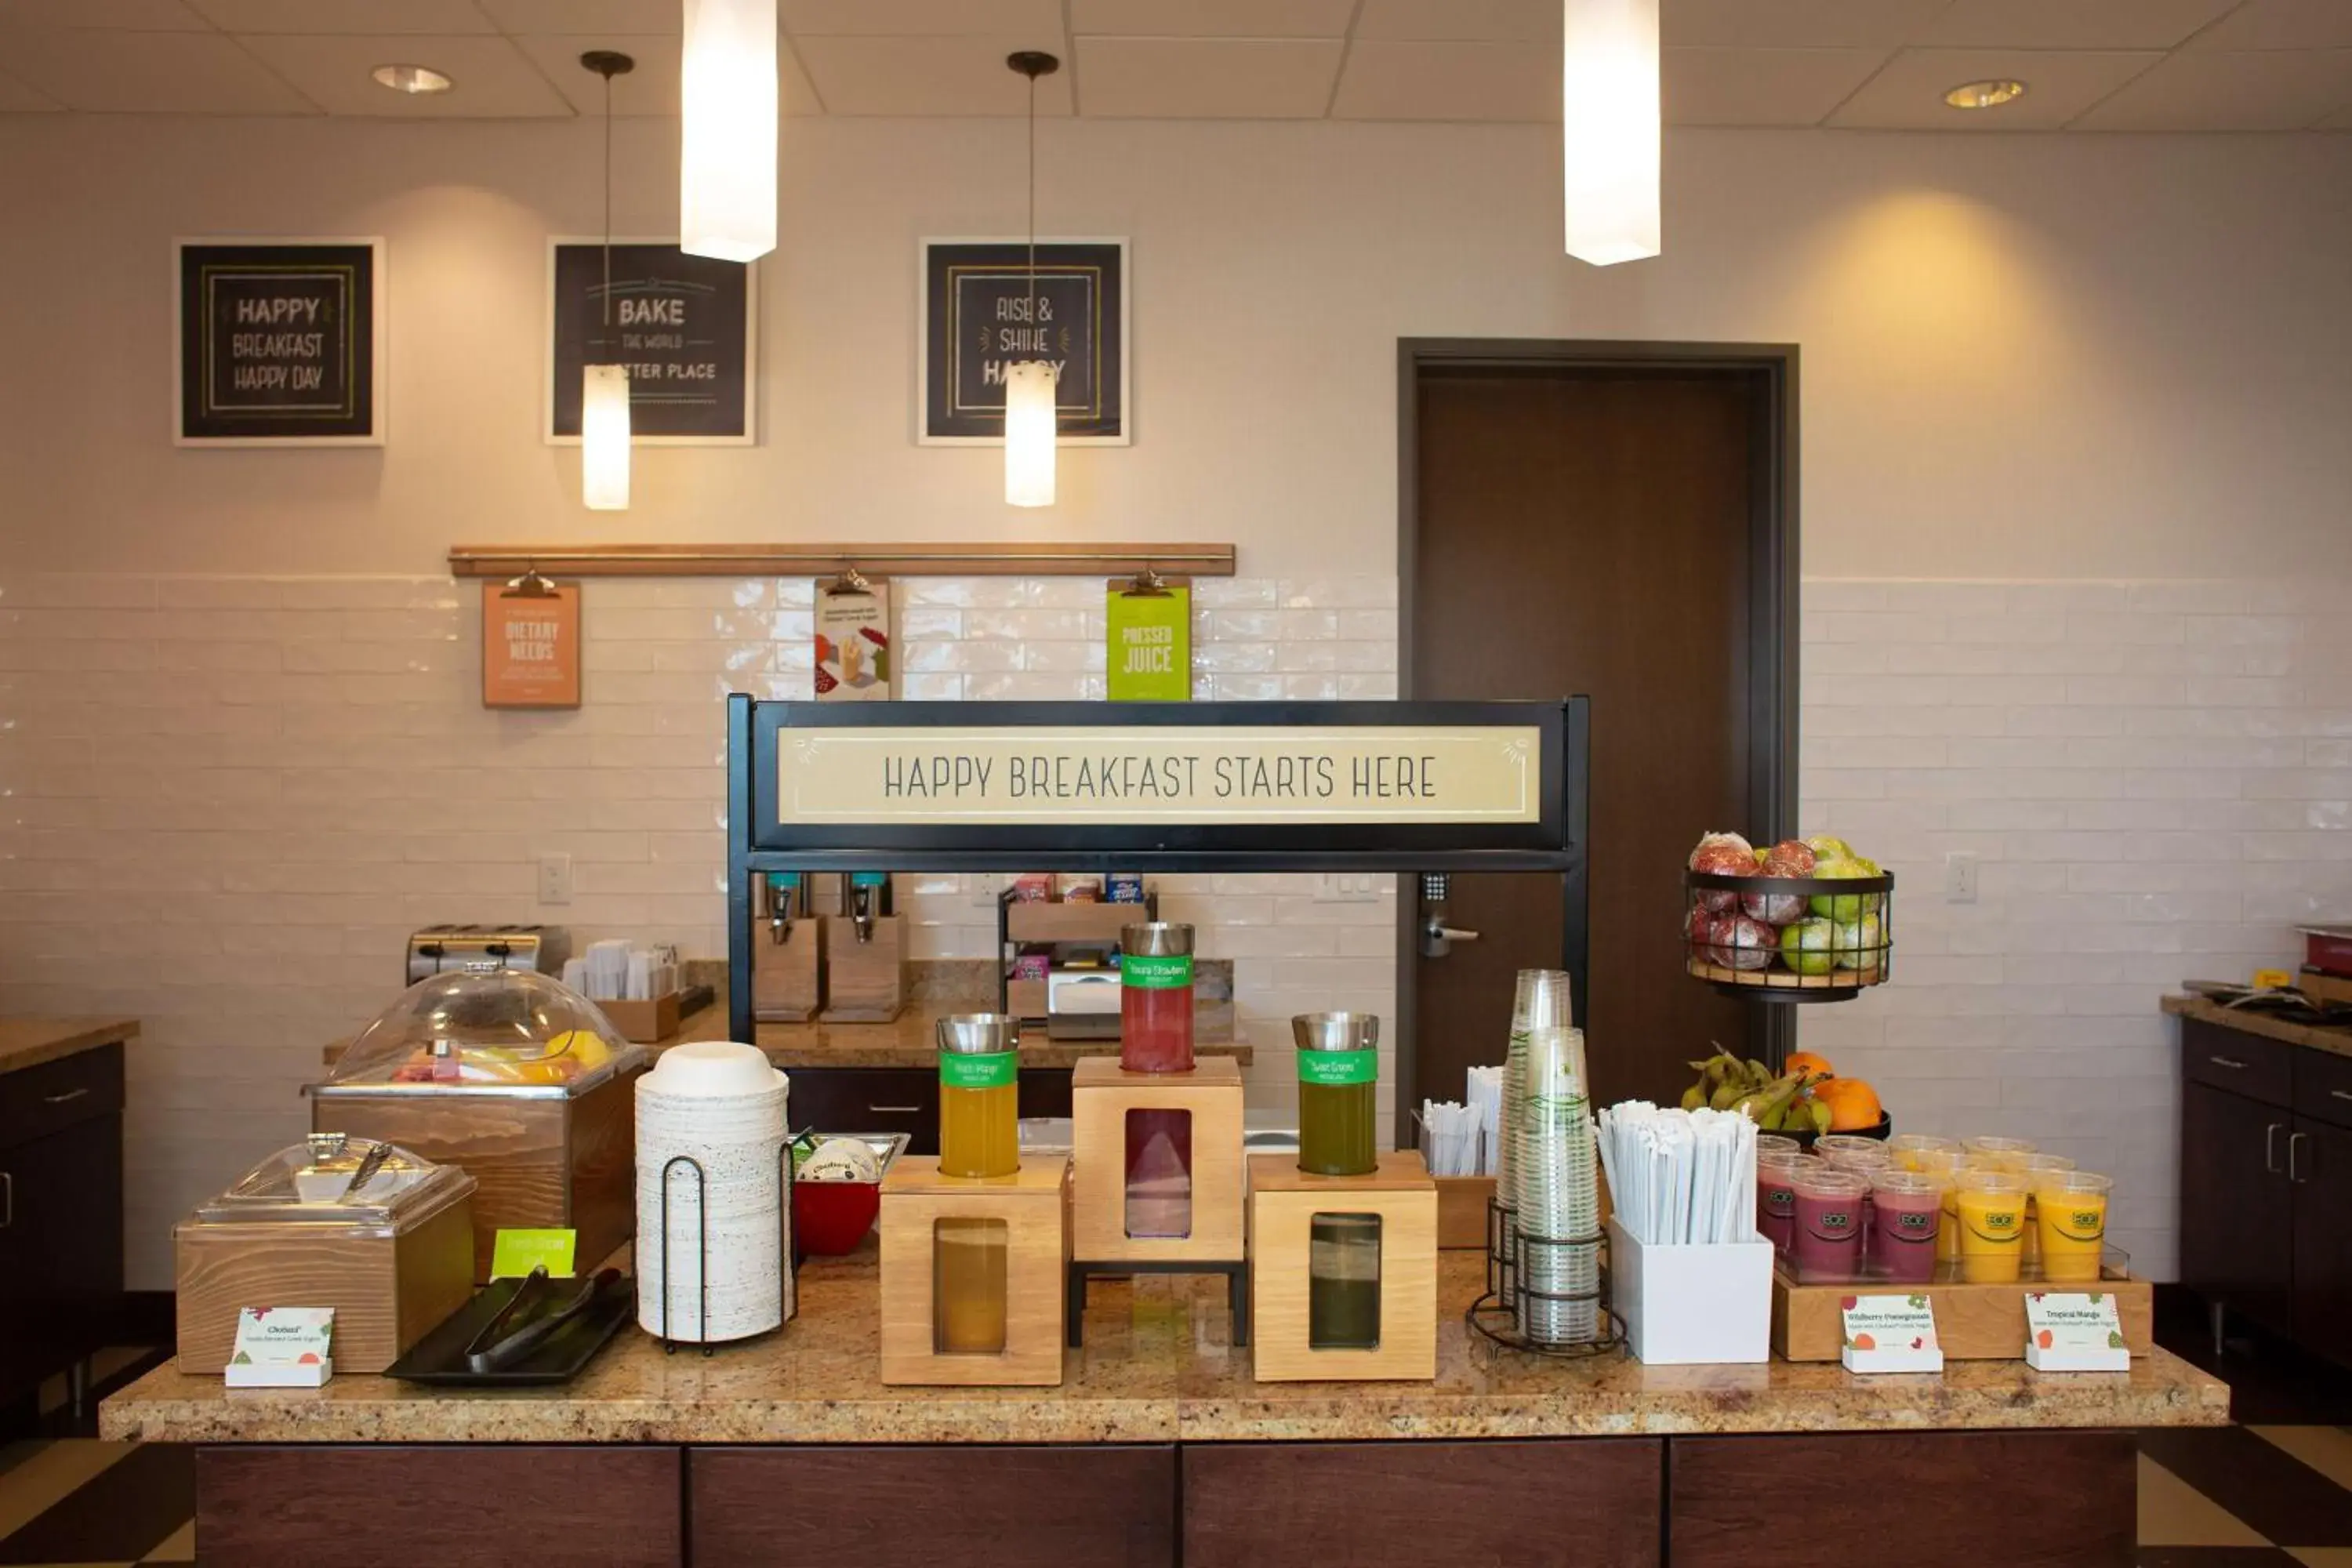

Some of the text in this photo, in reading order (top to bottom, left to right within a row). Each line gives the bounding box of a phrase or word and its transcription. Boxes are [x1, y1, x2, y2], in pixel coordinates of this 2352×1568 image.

[238, 298, 320, 325] HAPPY
[619, 299, 686, 325] BAKE
[996, 296, 1053, 321] RISE &
[233, 333, 324, 358] BREAKFAST
[1000, 328, 1048, 352] SHINE
[235, 365, 323, 390] HAPPY DAY
[667, 364, 716, 379] PLACE
[1122, 646, 1174, 673] JUICE
[884, 757, 1437, 798] HAPPY BREAKFAST STARTS HERE
